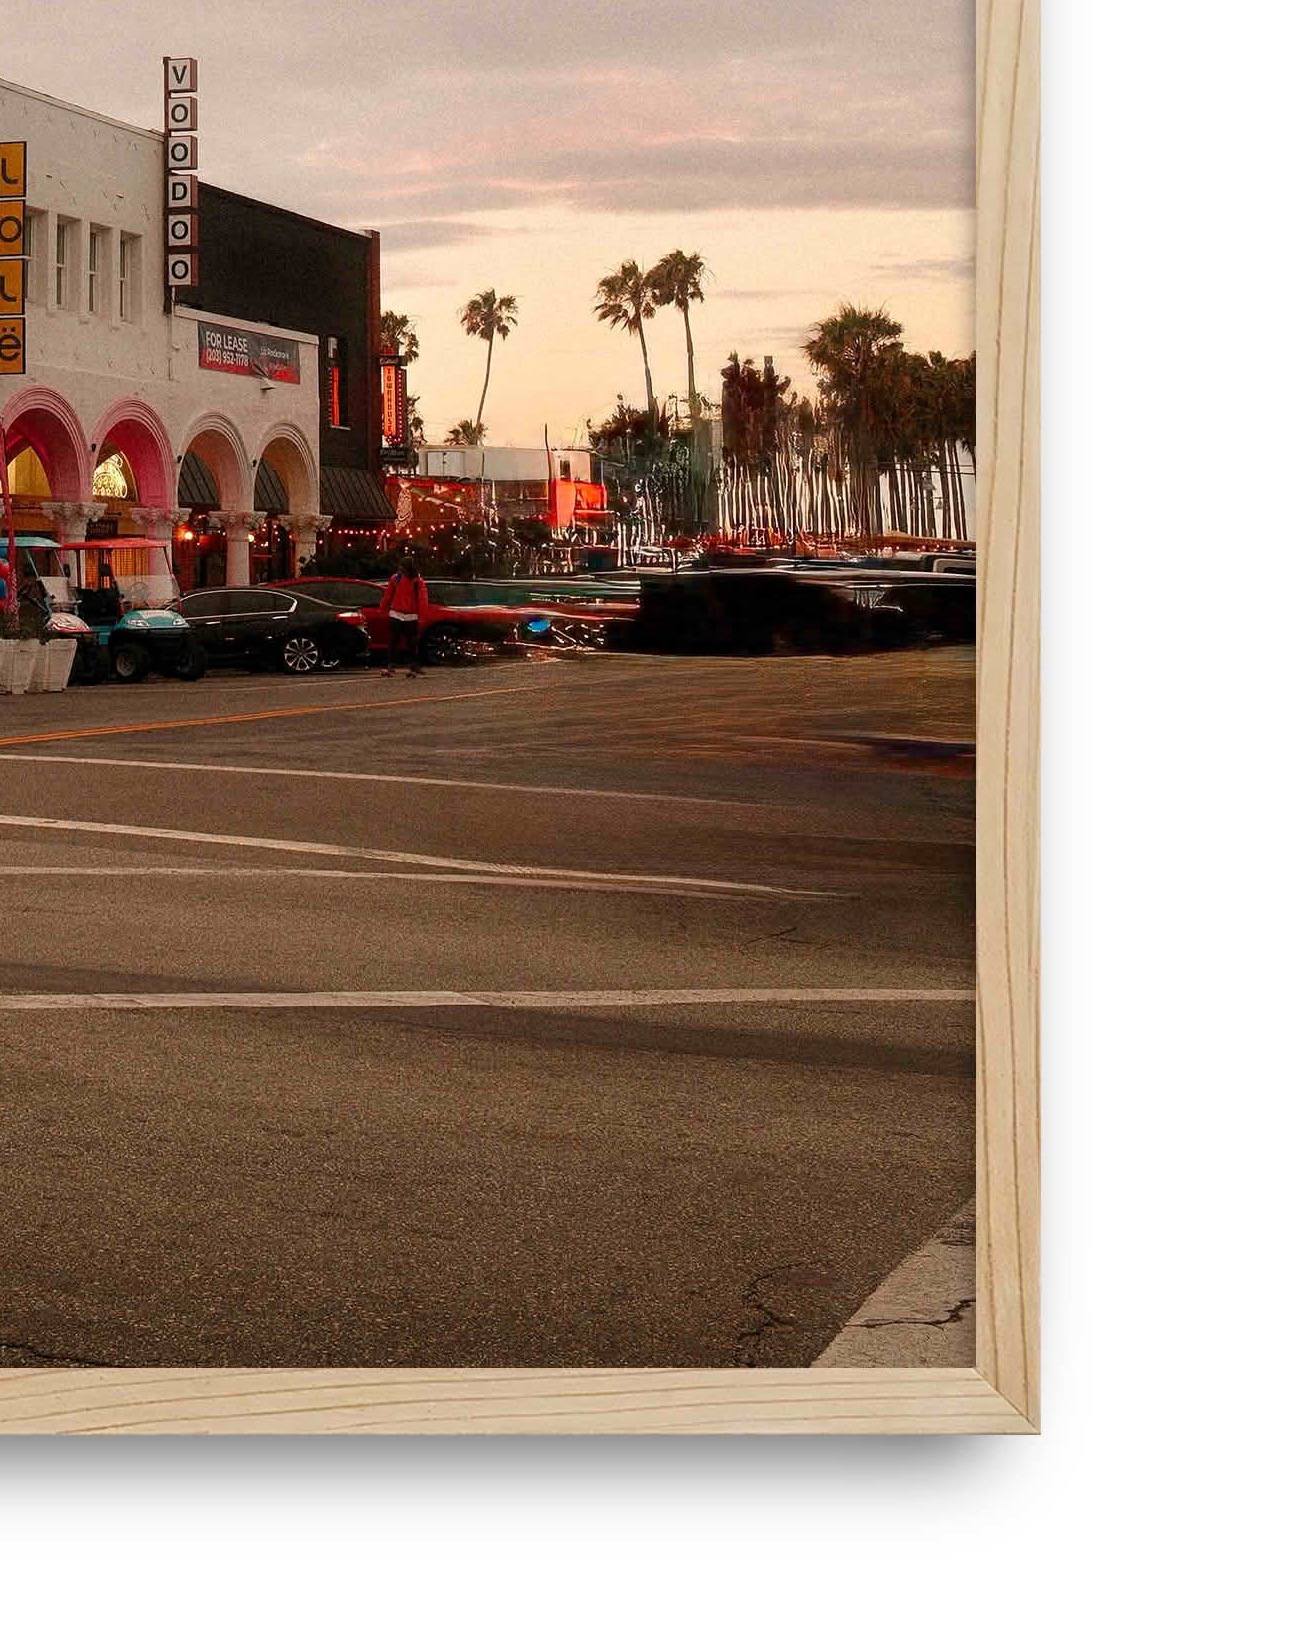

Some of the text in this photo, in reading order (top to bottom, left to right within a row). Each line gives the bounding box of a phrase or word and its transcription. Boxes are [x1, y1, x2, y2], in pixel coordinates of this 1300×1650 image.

[170, 64, 189, 281] VOODOO
[205, 331, 249, 352] FOR LEASE
